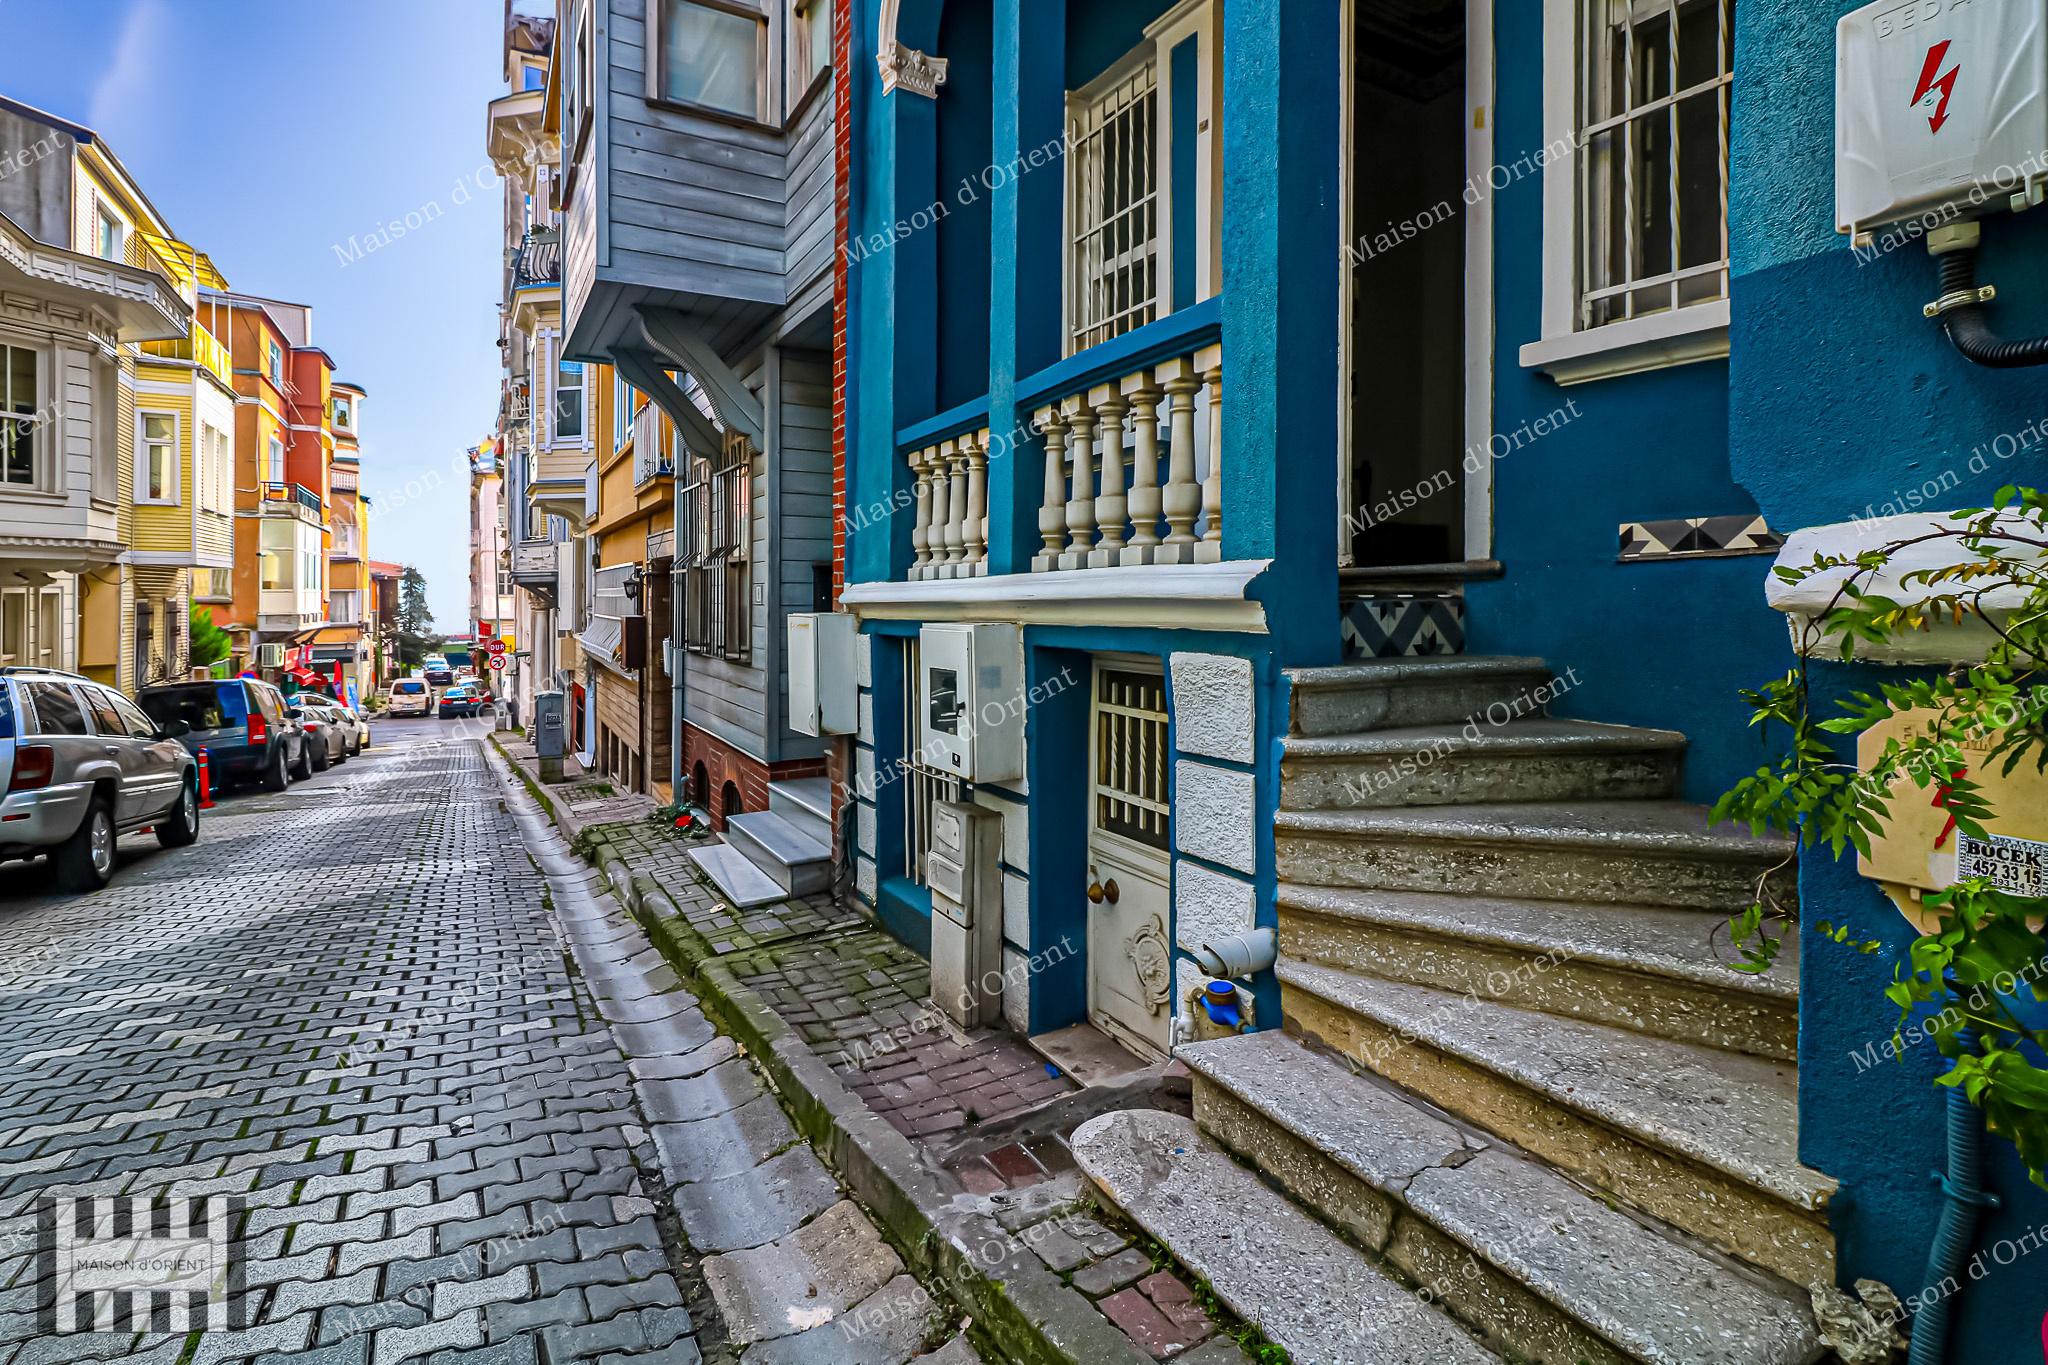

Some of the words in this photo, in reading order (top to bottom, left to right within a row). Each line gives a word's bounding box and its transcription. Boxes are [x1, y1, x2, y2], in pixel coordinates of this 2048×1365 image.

[1973, 860, 1997, 877] 452
[2002, 865, 2019, 881] 33
[2024, 869, 2041, 885] 15
[1992, 878, 2010, 887] 393
[2014, 882, 2025, 890] 14
[2029, 884, 2041, 893] 72
